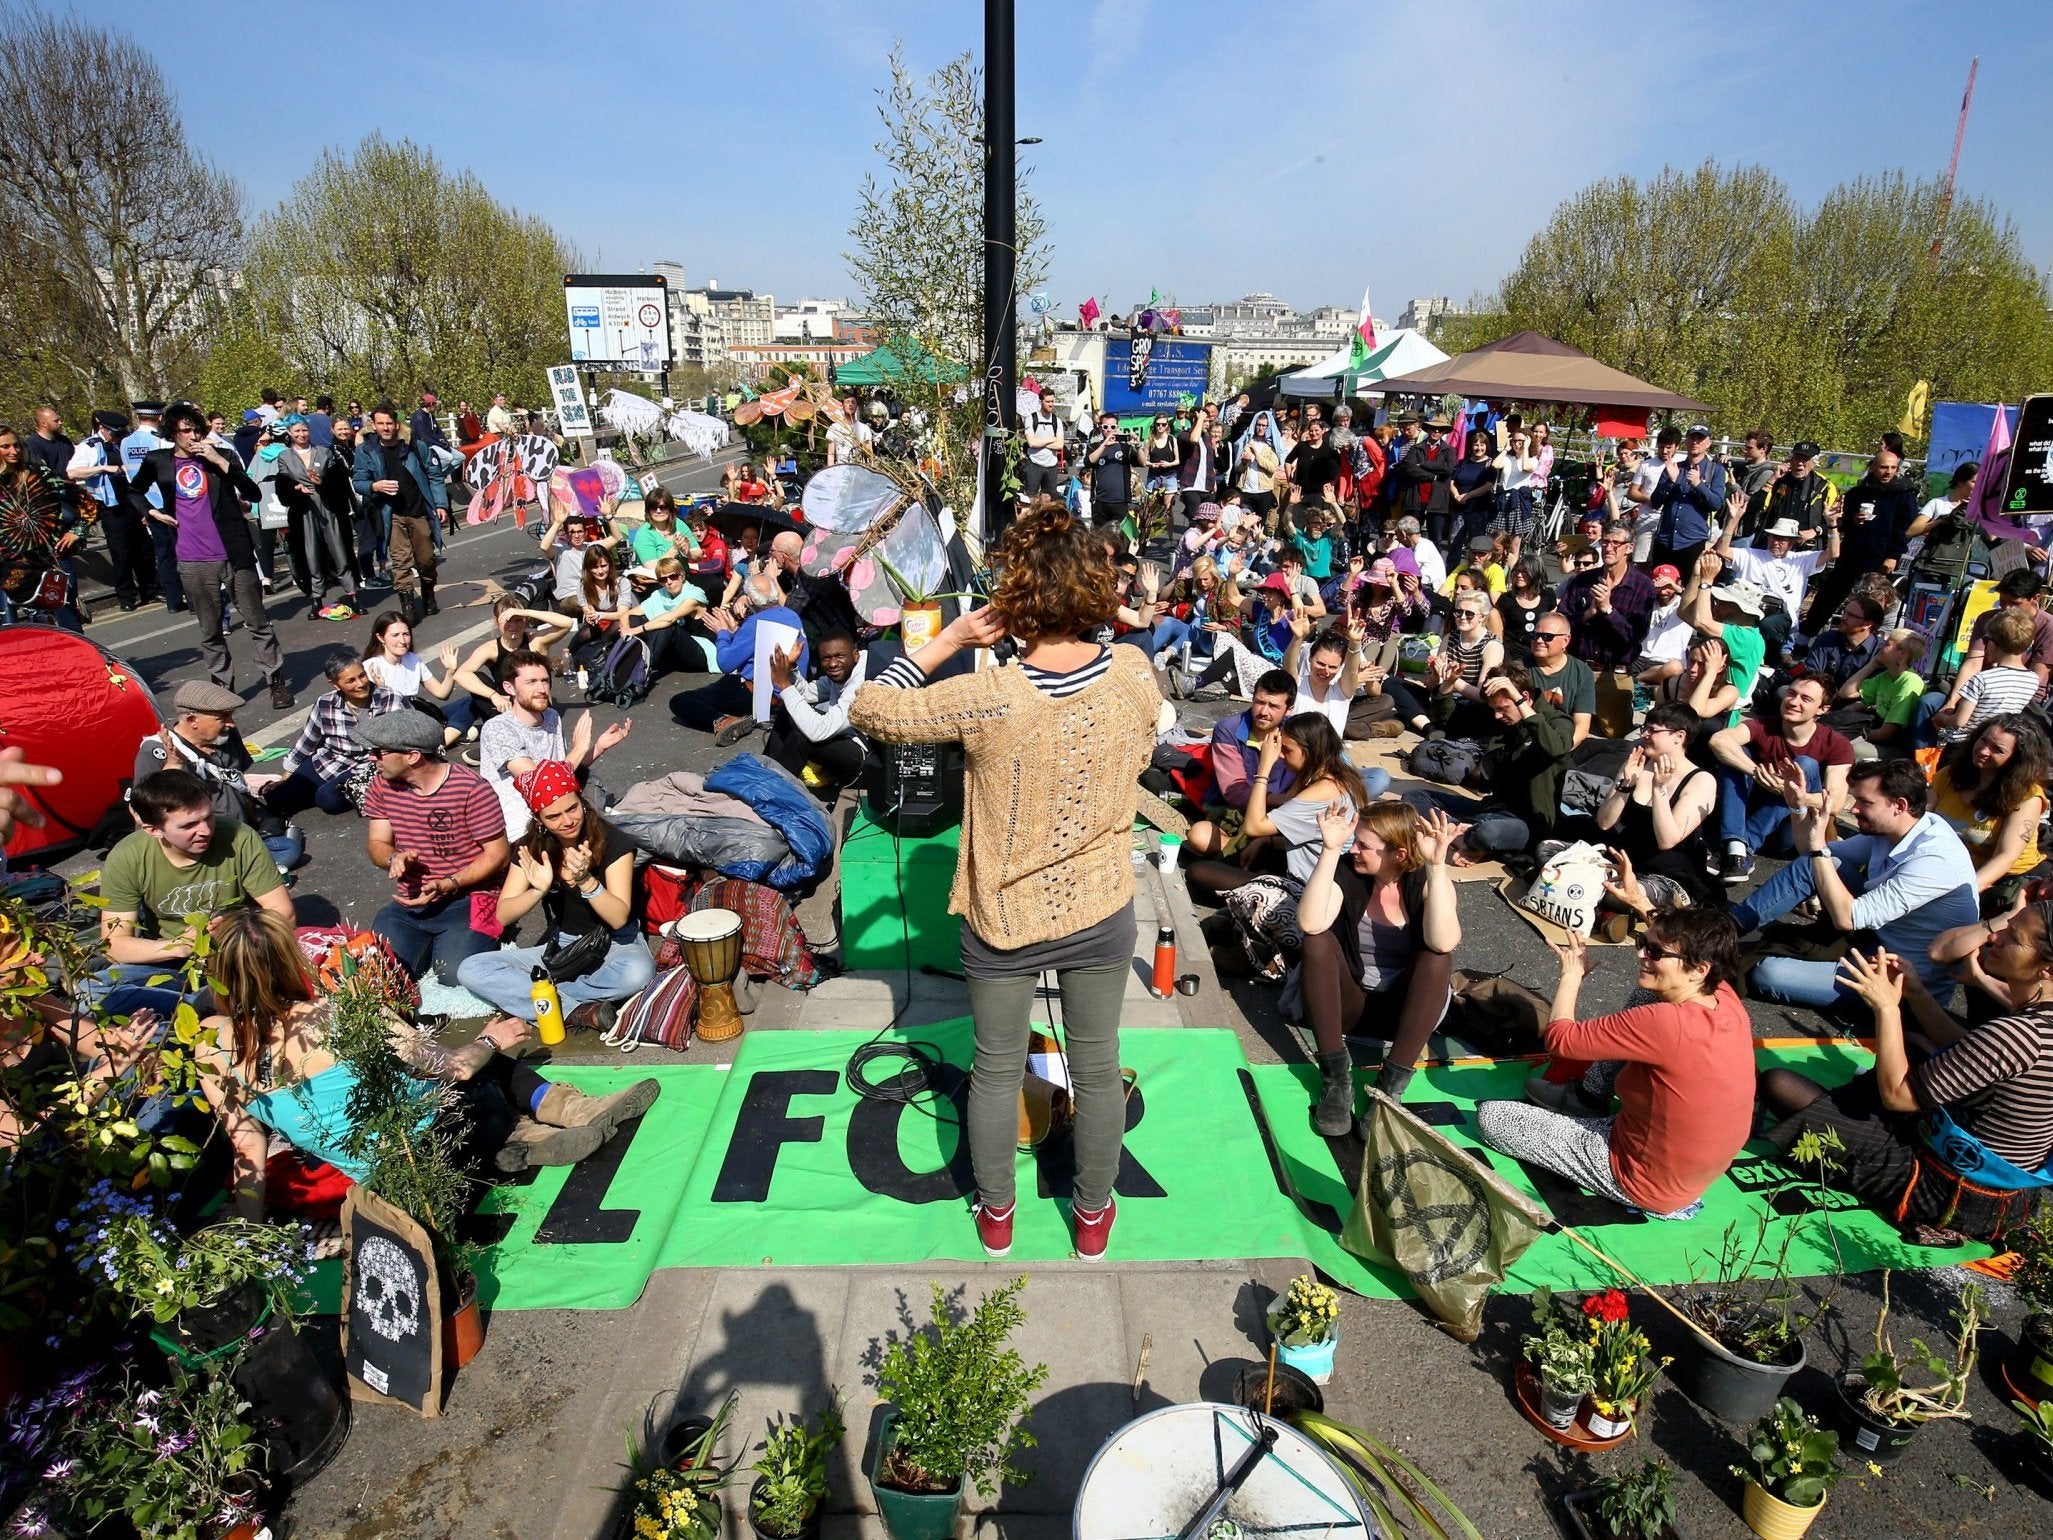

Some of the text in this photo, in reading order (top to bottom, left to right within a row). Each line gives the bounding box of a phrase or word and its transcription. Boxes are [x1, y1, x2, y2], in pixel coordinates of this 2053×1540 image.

[1160, 365, 1191, 375] Transport
[127, 446, 149, 455] POLICE
[711, 1061, 1168, 1203] FOR
